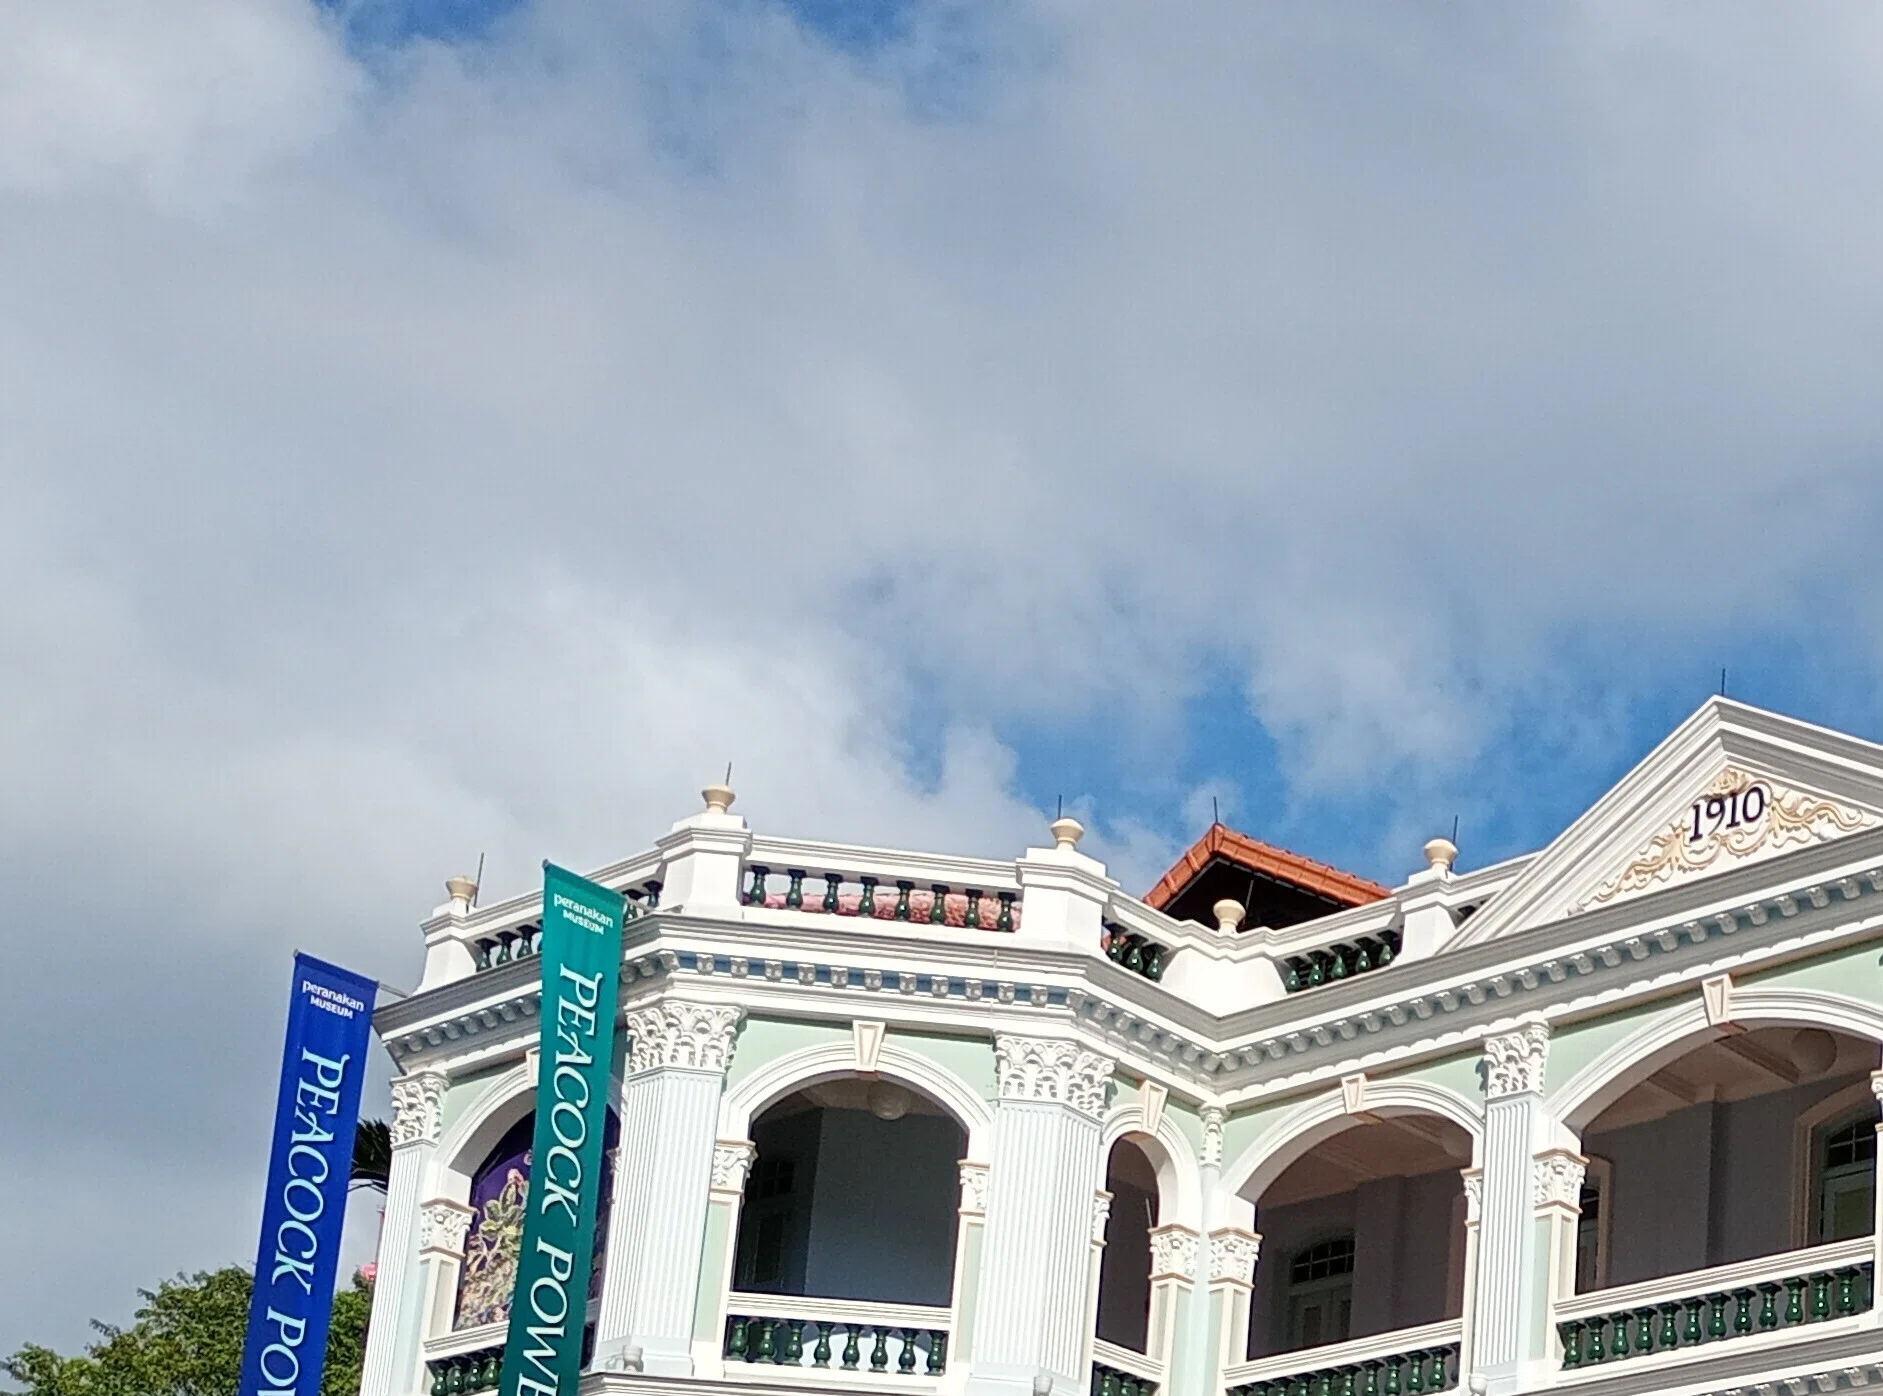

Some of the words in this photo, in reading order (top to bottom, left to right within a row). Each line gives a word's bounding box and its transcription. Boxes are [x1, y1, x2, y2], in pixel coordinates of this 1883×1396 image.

[1689, 786, 1765, 843] 1910
[553, 893, 614, 929] peranakan
[302, 980, 364, 1012] peranakan
[310, 994, 354, 1019] MUSEUM
[541, 962, 604, 1227] PEACOCK
[271, 1047, 351, 1295] PEACOCK
